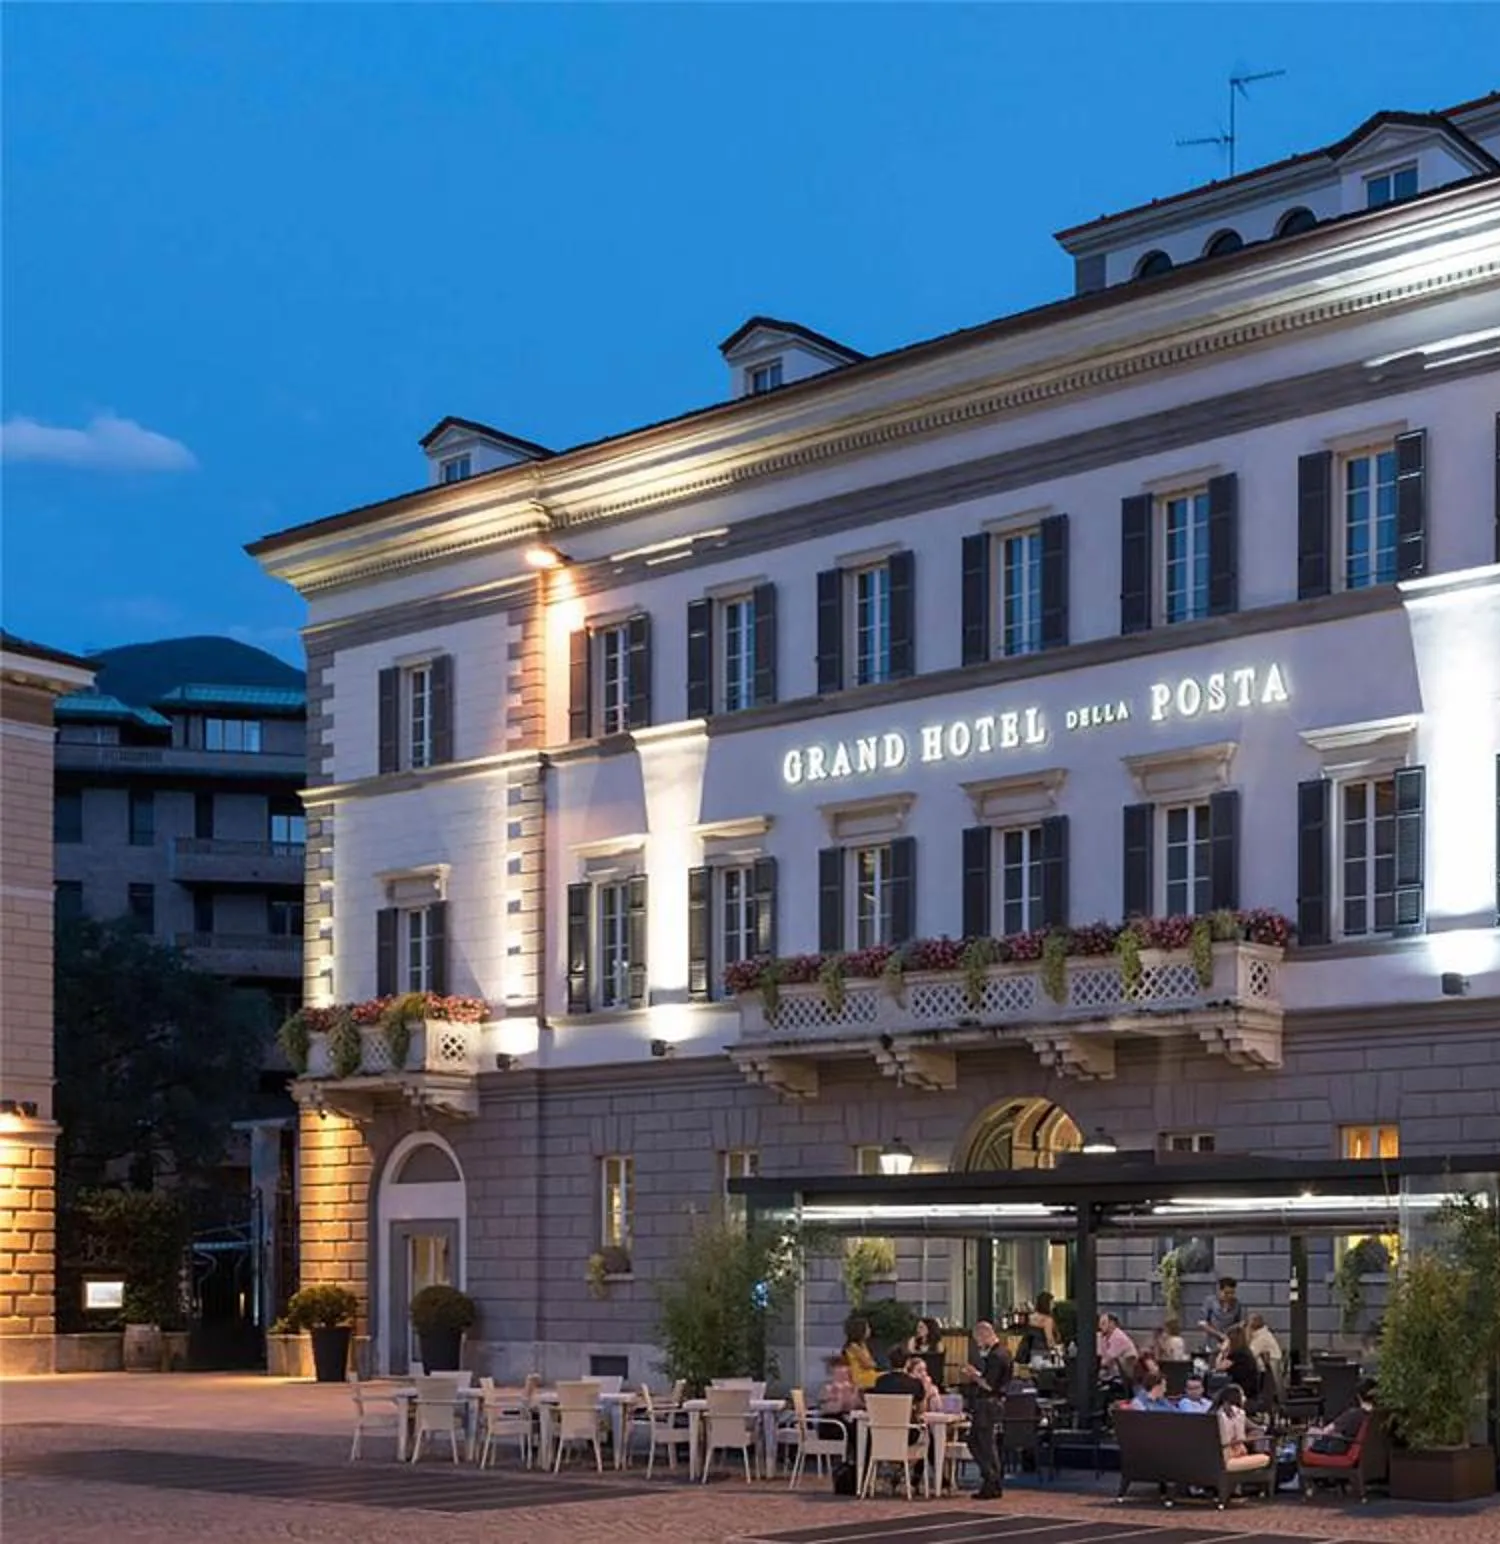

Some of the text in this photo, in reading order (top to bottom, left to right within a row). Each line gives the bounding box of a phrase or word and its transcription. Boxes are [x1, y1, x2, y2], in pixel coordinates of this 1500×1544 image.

[783, 662, 1289, 785] GRAND HOTEL DELLA POSTA
